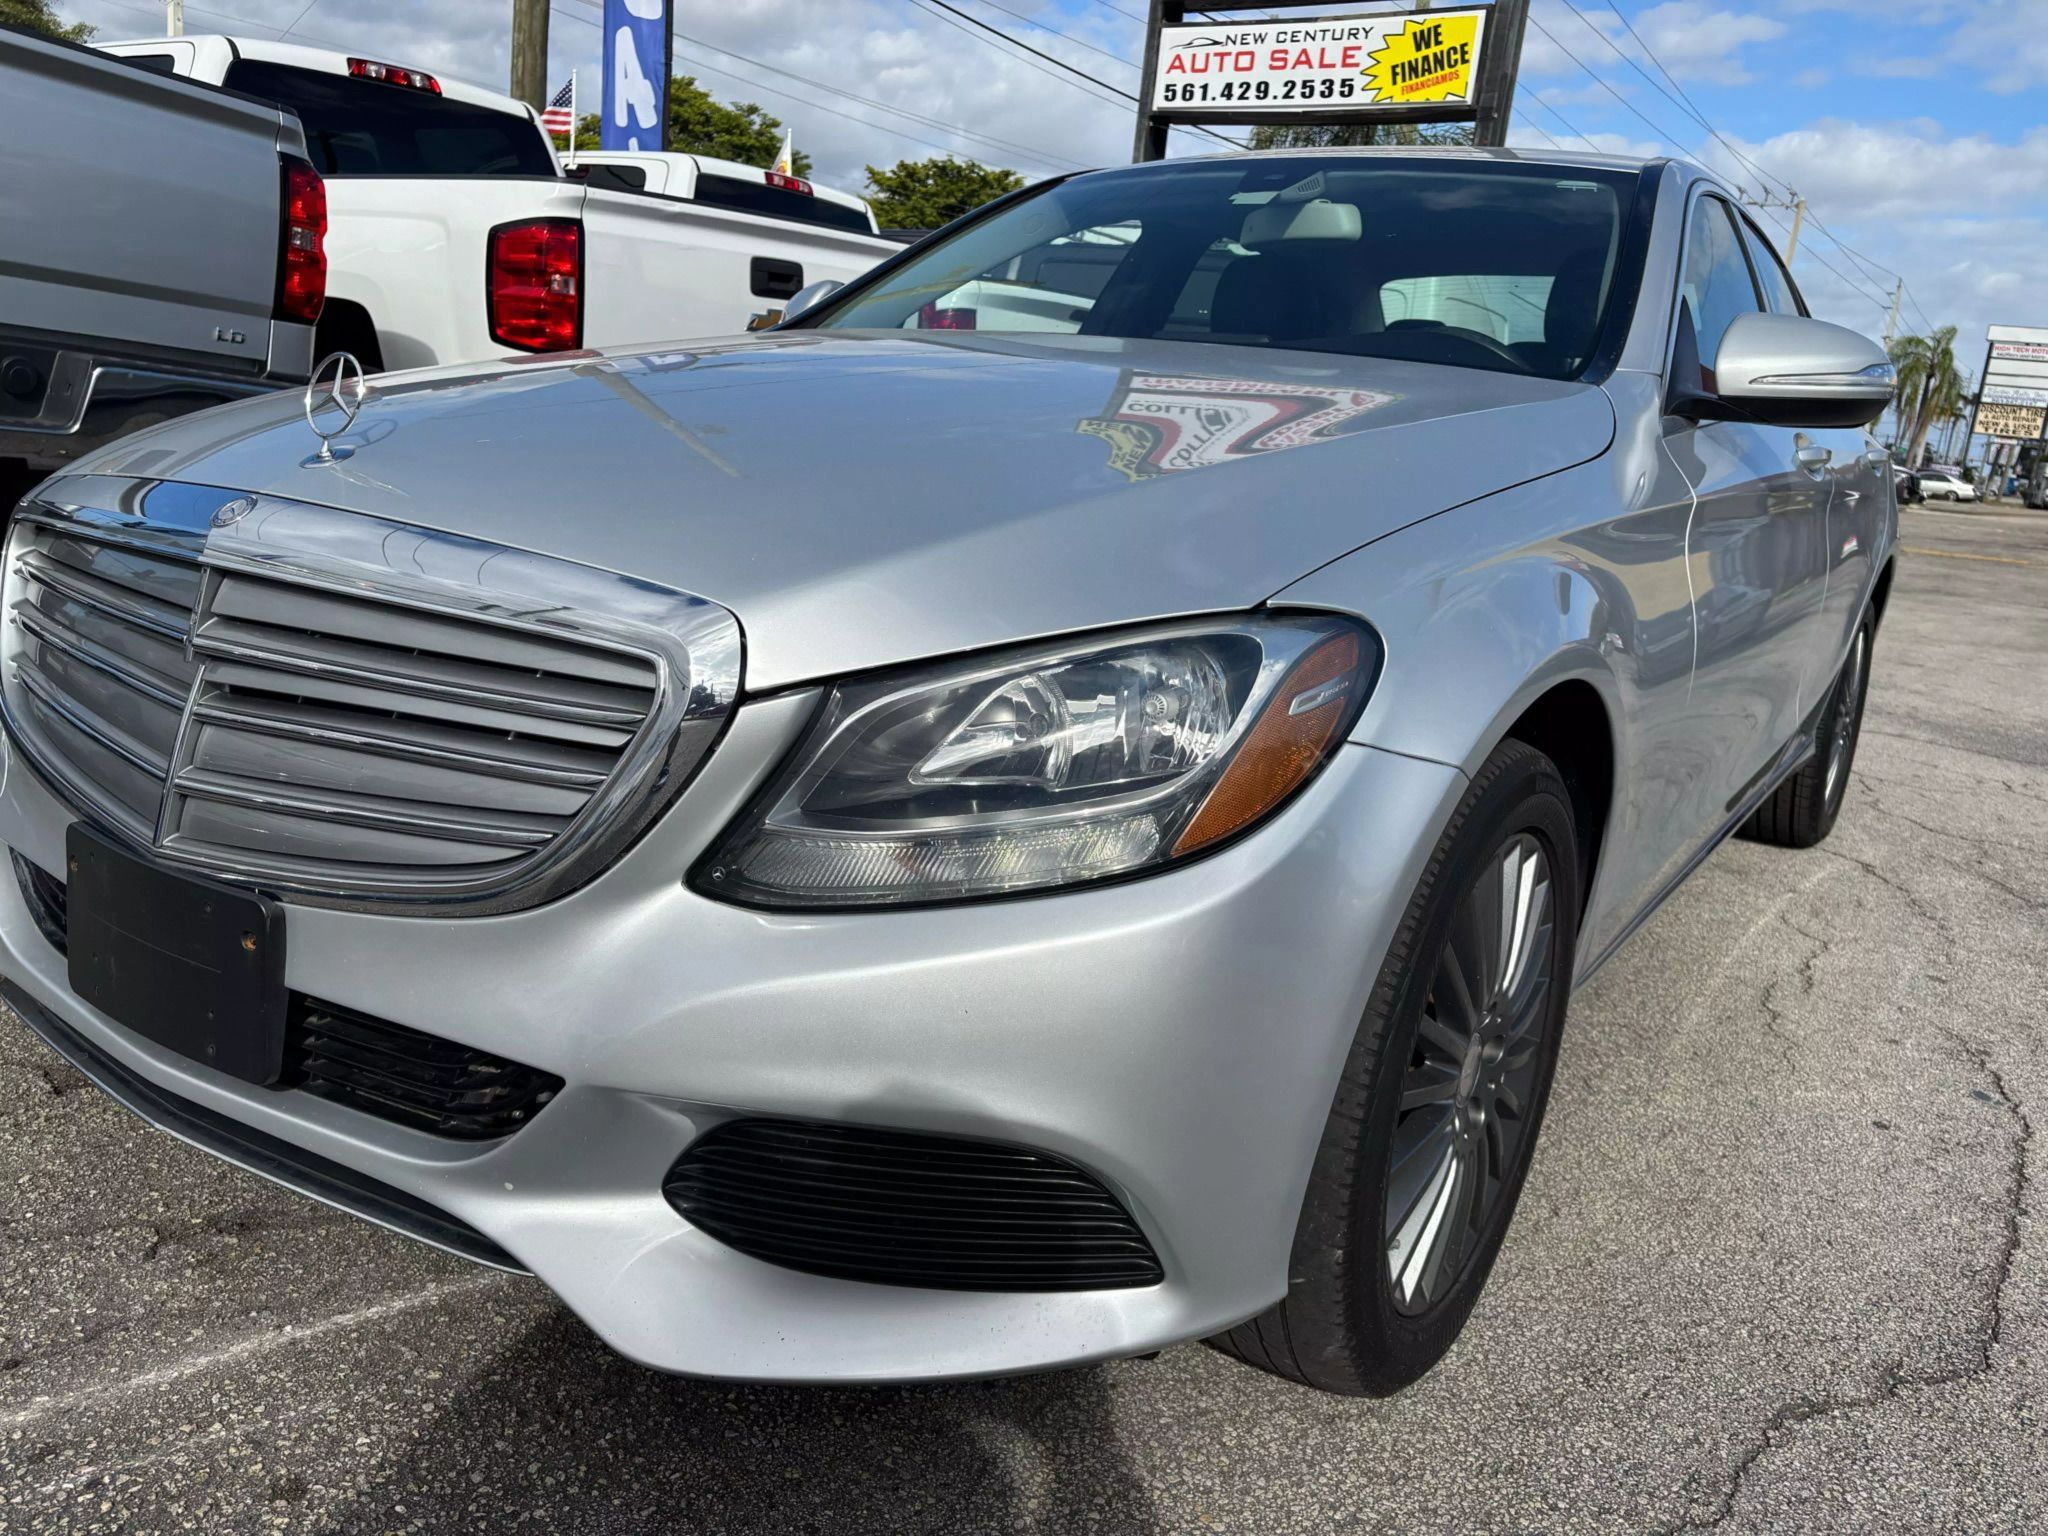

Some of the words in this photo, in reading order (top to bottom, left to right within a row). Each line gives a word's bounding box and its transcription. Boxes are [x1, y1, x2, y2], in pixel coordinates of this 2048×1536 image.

[1225, 32, 1268, 46] NEW
[1276, 26, 1375, 44] CENTURY
[1412, 23, 1443, 52] WE
[1166, 50, 1255, 74] AUTO
[1268, 46, 1362, 70] SALE
[1391, 42, 1470, 86] FINANCE
[1163, 78, 1355, 102] 561.429.2535
[1401, 69, 1460, 96] FINANCIAMOS
[1980, 404, 2023, 415] DISCOUNT
[2026, 407, 2046, 418] TIRE
[1982, 425, 2033, 436] TIRES
[2013, 423, 2040, 431] USED
